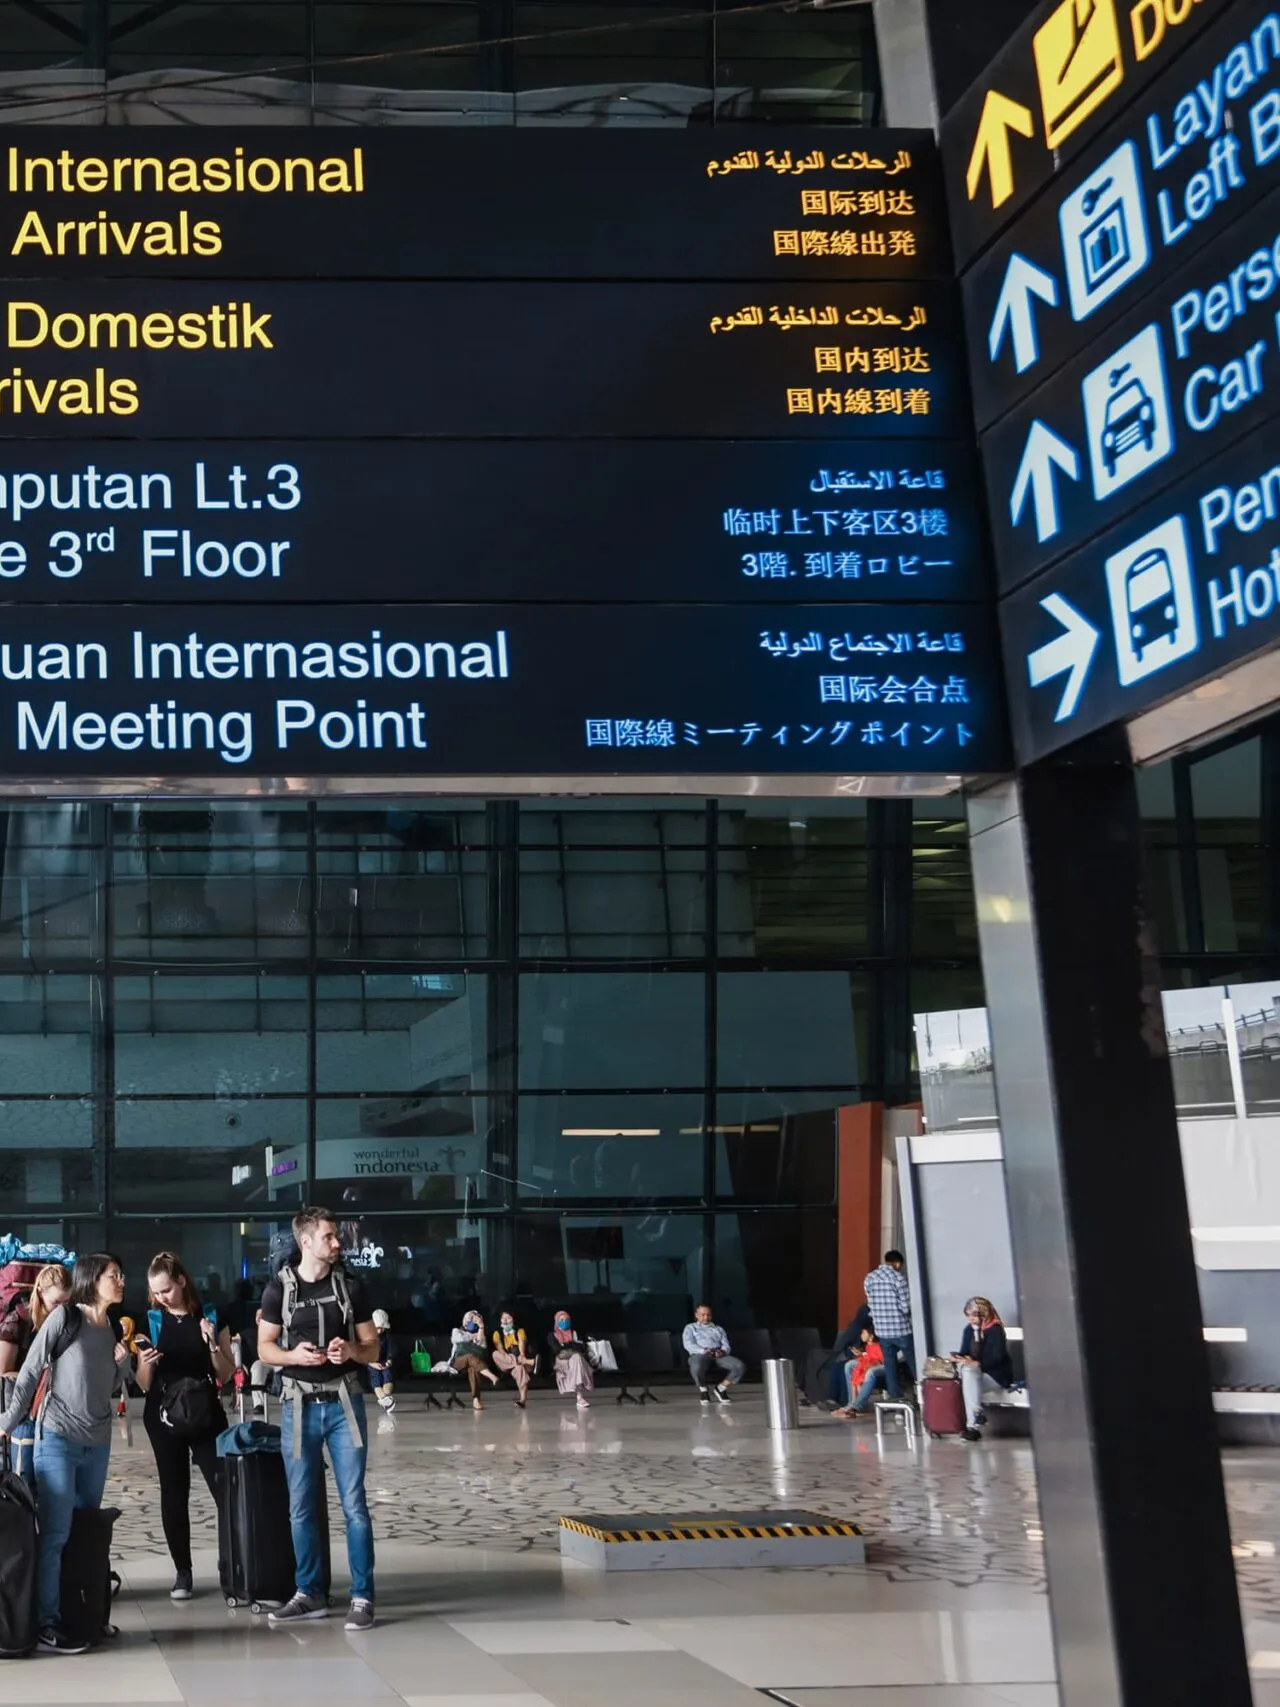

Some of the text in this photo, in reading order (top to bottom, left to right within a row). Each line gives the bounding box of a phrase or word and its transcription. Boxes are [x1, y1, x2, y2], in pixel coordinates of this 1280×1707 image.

[1147, 14, 1280, 170] Layan
[10, 148, 363, 192] Internasional
[707, 151, 911, 177] الرحلات الدولية القدوم
[801, 190, 915, 215] 国际到达
[1158, 133, 1245, 245] Left
[12, 211, 221, 255] Arrivals
[774, 230, 916, 256] 国際線出発
[1172, 234, 1280, 358] Pers
[9, 302, 273, 348] Domestik
[710, 306, 926, 333] الرحلات الداخلية القدوم
[815, 347, 930, 373] 国内到达
[787, 388, 930, 414] 国内線到着
[1185, 340, 1265, 431] Car
[196, 463, 300, 510] Lt.3
[810, 469, 945, 494] قاعة الاستقبال
[723, 508, 948, 536] 临时上下客区3楼
[49, 527, 114, 577] 3rd
[143, 530, 290, 577] Floor
[134, 631, 508, 678] Internasional
[760, 631, 964, 662] قاعة الاجتماع الدولية
[819, 674, 970, 704] 国际会合点
[18, 701, 252, 762] Meeting
[277, 700, 426, 748] Point
[353, 1147, 419, 1160] wonderful
